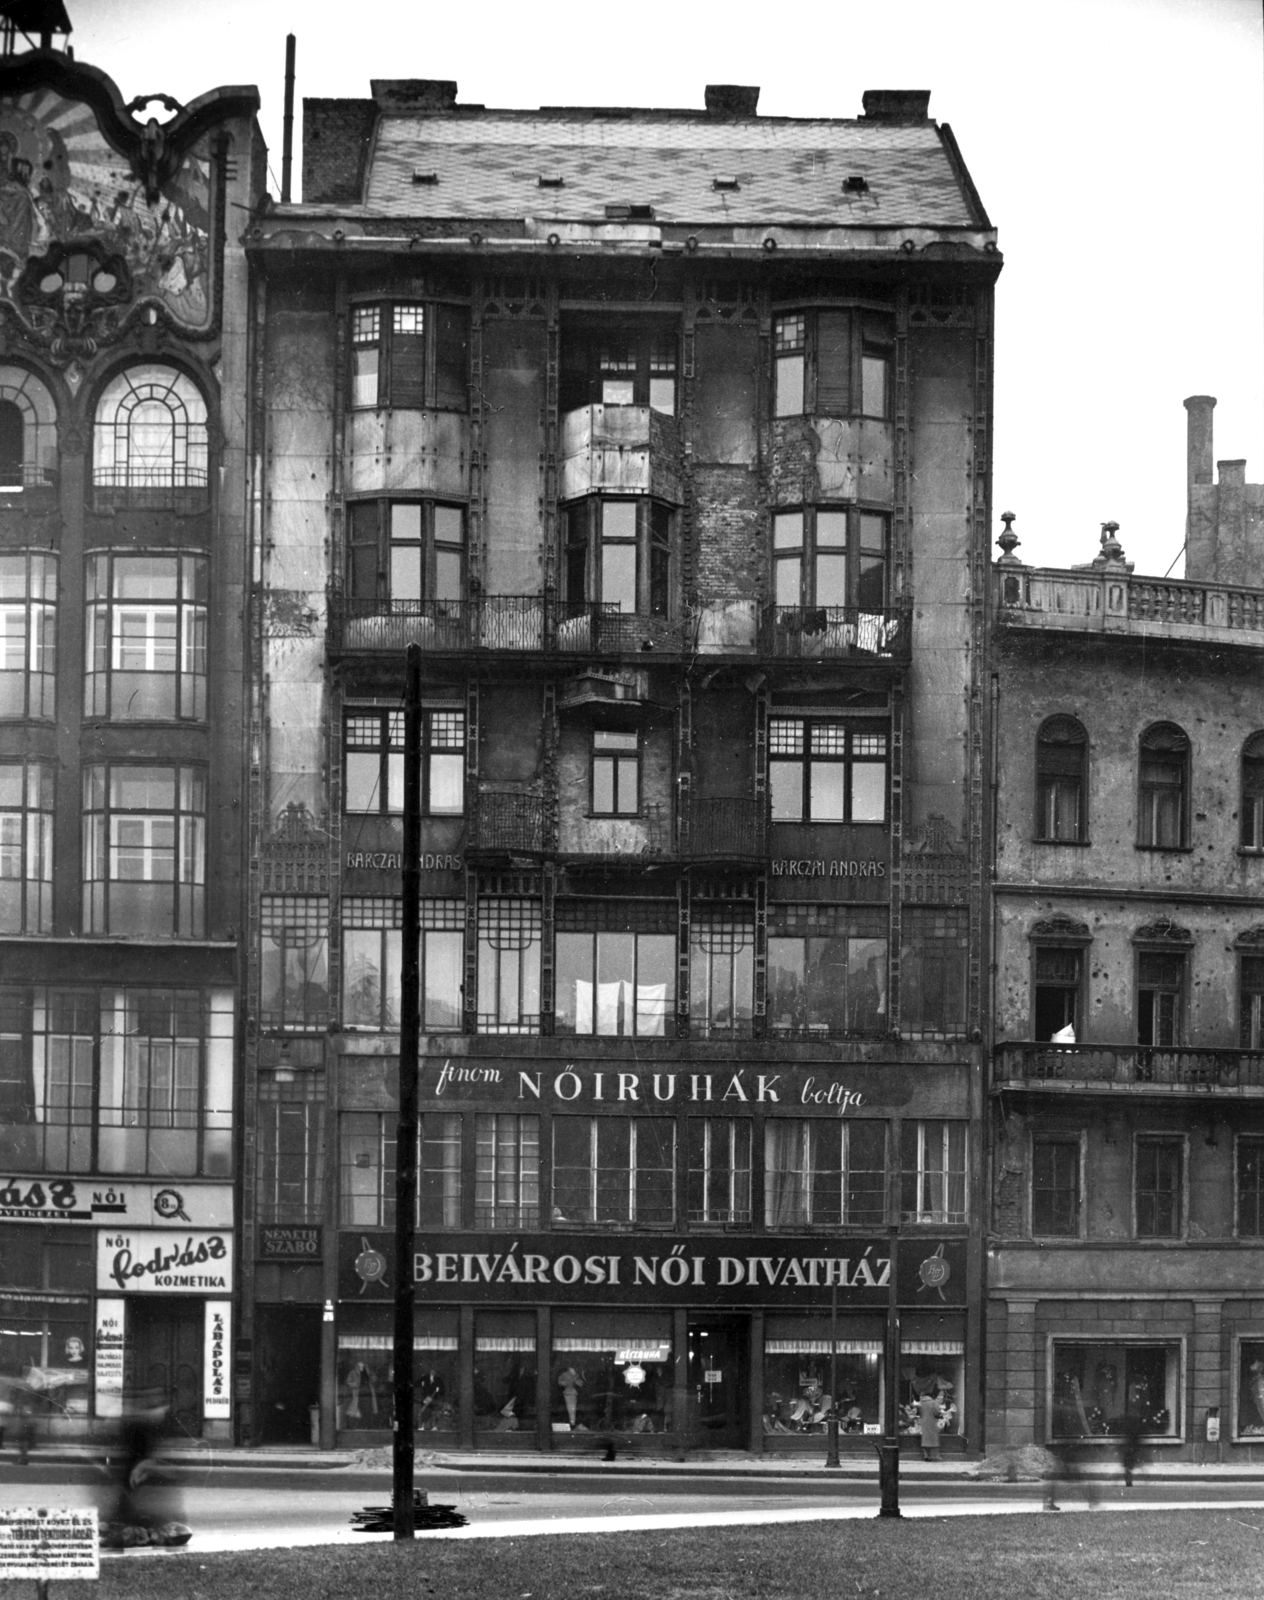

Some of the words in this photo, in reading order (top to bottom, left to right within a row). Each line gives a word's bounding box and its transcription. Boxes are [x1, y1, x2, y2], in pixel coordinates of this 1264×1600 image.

[435, 1058, 503, 1095] finom
[800, 1076, 867, 1116] boltja
[92, 1187, 125, 1204] NŐI
[264, 1228, 318, 1239] NÉMETH
[105, 1234, 130, 1248] NŐI
[265, 1239, 318, 1253] SZABÓ
[413, 1242, 621, 1285] BELVÁROSI
[632, 1245, 706, 1287] NŐI
[717, 1245, 891, 1287] DIVATHÁZ
[154, 1275, 226, 1288] KOZMETIKA
[102, 1318, 118, 1328] NŐI
[211, 1313, 225, 1395] LÁBÁPOLÁS
